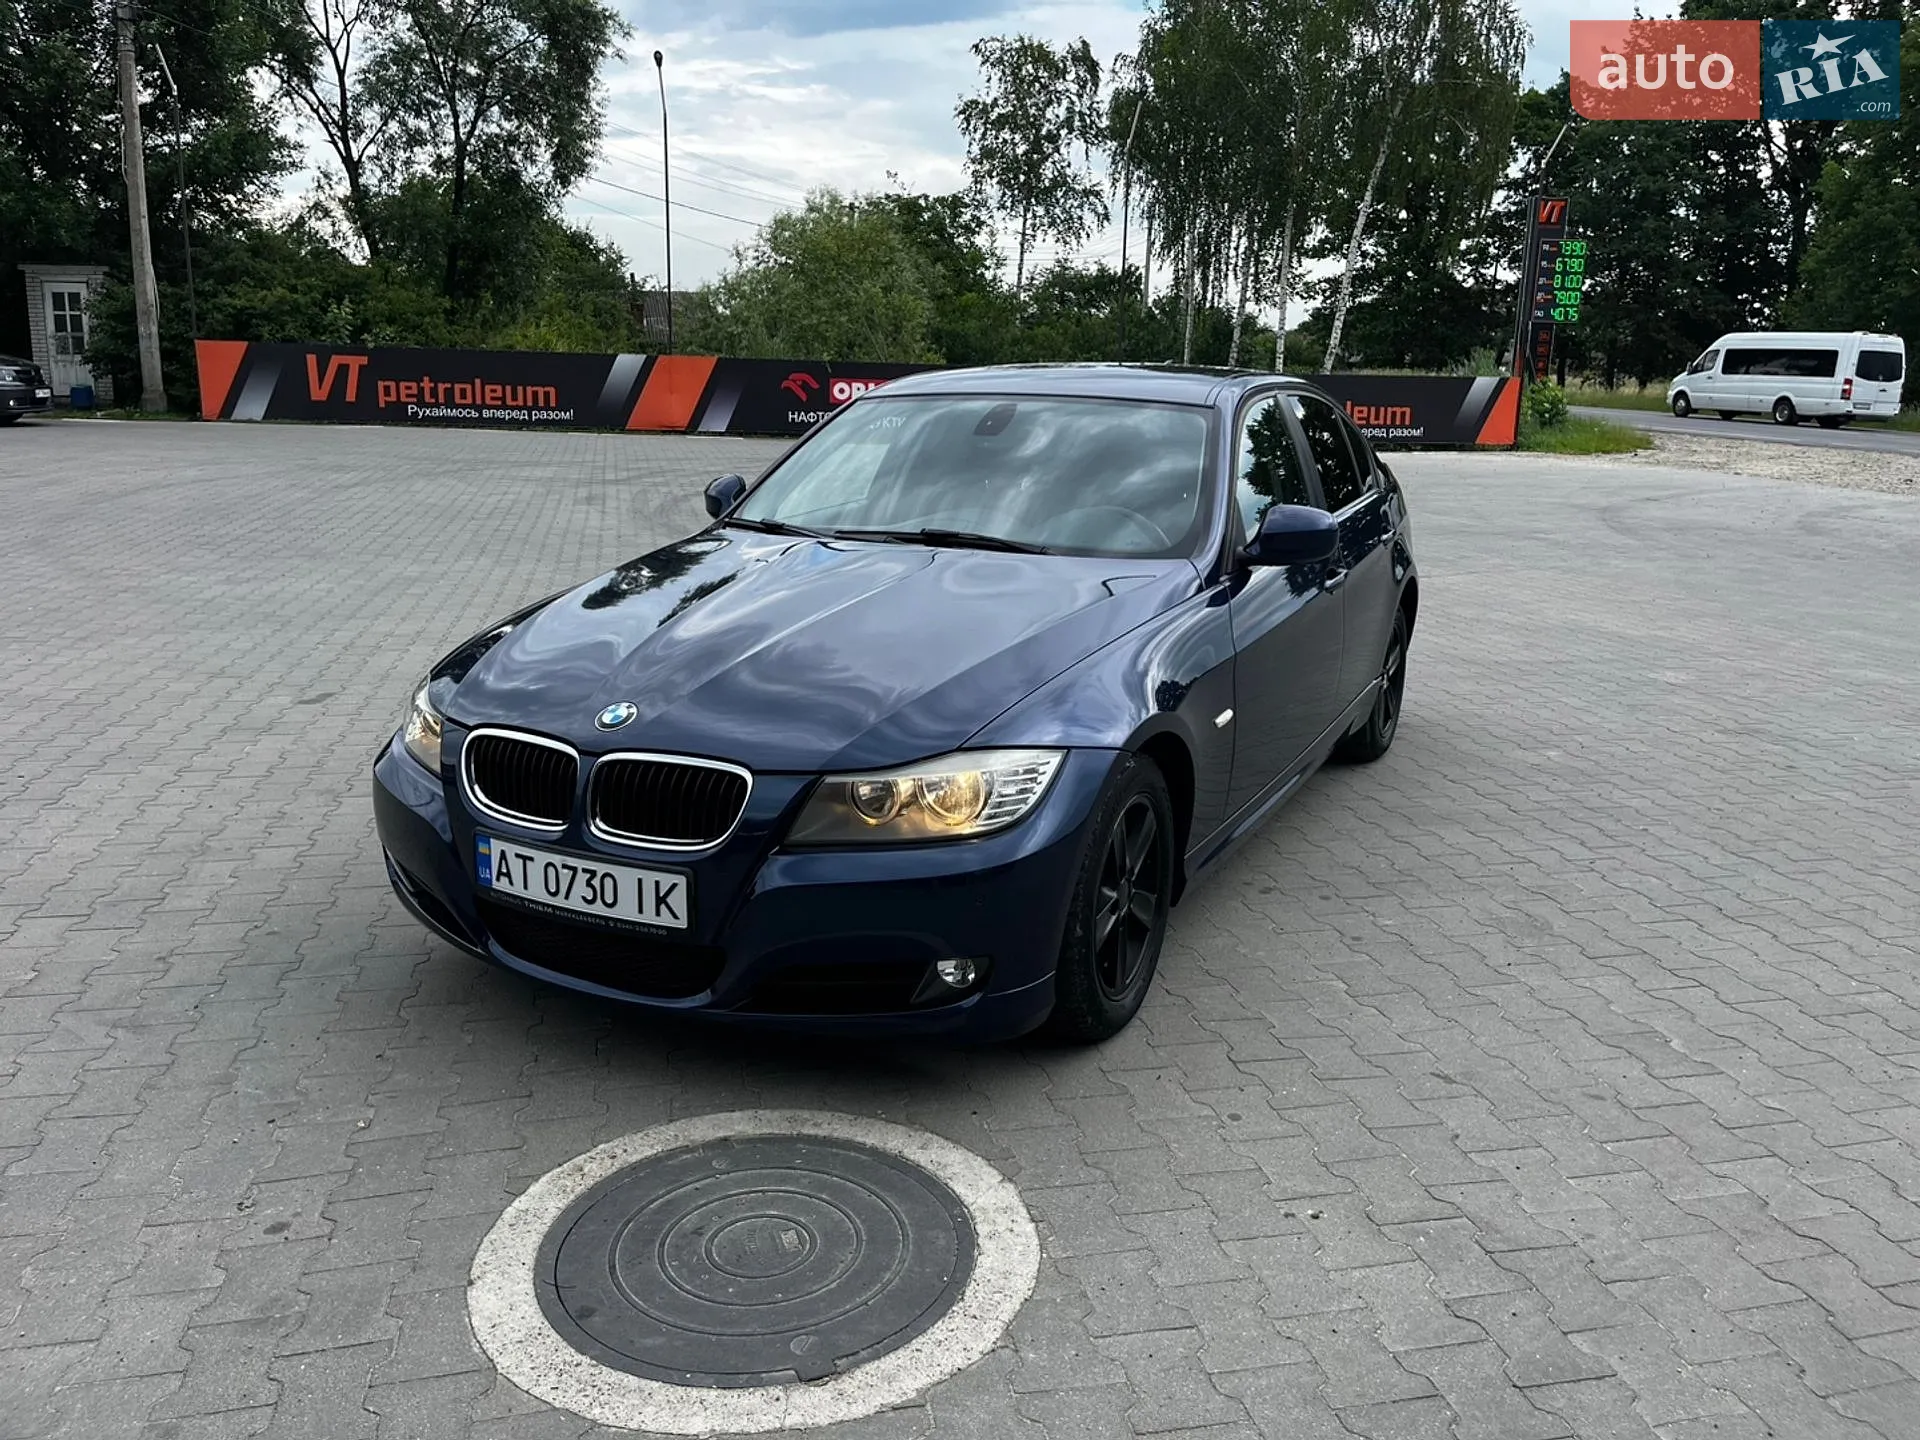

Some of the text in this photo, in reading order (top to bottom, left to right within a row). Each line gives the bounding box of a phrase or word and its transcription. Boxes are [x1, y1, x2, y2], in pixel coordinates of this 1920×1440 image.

[1538, 199, 1567, 223] VT
[305, 353, 557, 409] VT petroleum
[407, 404, 574, 422] Рухаймось вперед разом!
[1389, 426, 1424, 438] разом!
[478, 866, 491, 880] UA
[495, 849, 681, 921] AT 0730 IK
